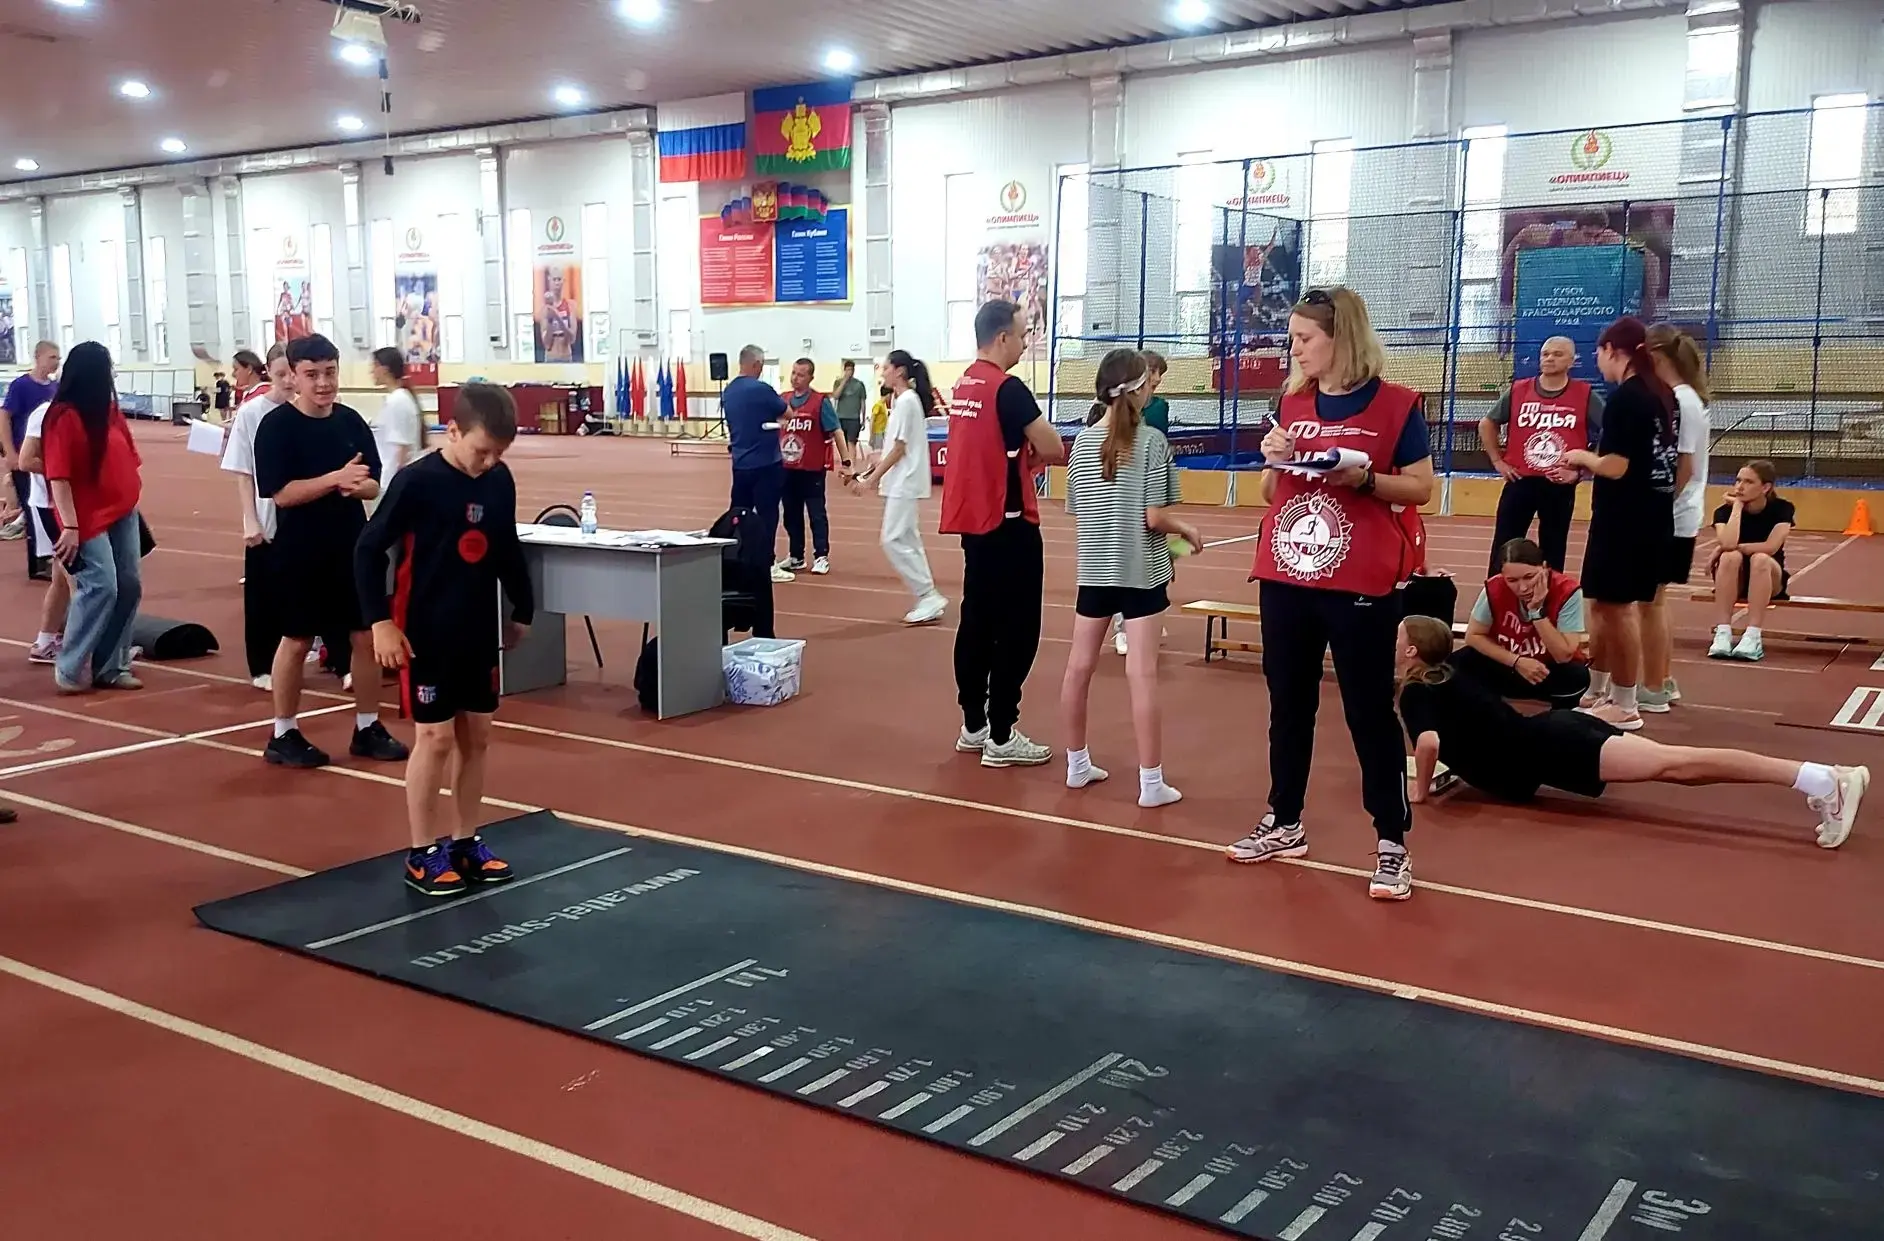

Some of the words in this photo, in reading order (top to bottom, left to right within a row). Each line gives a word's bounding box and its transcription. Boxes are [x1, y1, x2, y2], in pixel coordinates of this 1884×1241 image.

[1549, 171, 1630, 184] «ОЛИМПИЕЦ»
[1226, 194, 1291, 206] «ОЛМПИЕЦ»
[1537, 297, 1600, 307] ГУБЕРНАТОРА
[1553, 287, 1584, 297] КУБОК
[1522, 306, 1615, 317] КРАСНОДАРСКОГО
[1520, 403, 1541, 414] ГТО
[786, 418, 813, 432] ДЬЯ
[1518, 412, 1577, 430] СУДЬЯ
[666, 998, 714, 1019] 1.10
[699, 1007, 747, 1028] 1.20
[733, 1016, 781, 1037] 1.30
[770, 1025, 817, 1047] 1.40
[807, 1037, 855, 1063] 1.50
[845, 1047, 893, 1070] 1.60
[884, 1058, 933, 1082] 1.70
[968, 1079, 1017, 1106] 1.90
[1056, 1102, 1107, 1131] 2.10
[1103, 1115, 1154, 1145] 2.20
[1152, 1129, 1204, 1160] 2.30
[1203, 1143, 1256, 1174] 2.40
[1257, 1157, 1309, 1190] 2.50
[1312, 1171, 1364, 1206] 2.60
[1370, 1187, 1423, 1222] 2.70
[1431, 1203, 1482, 1239] 2.80
